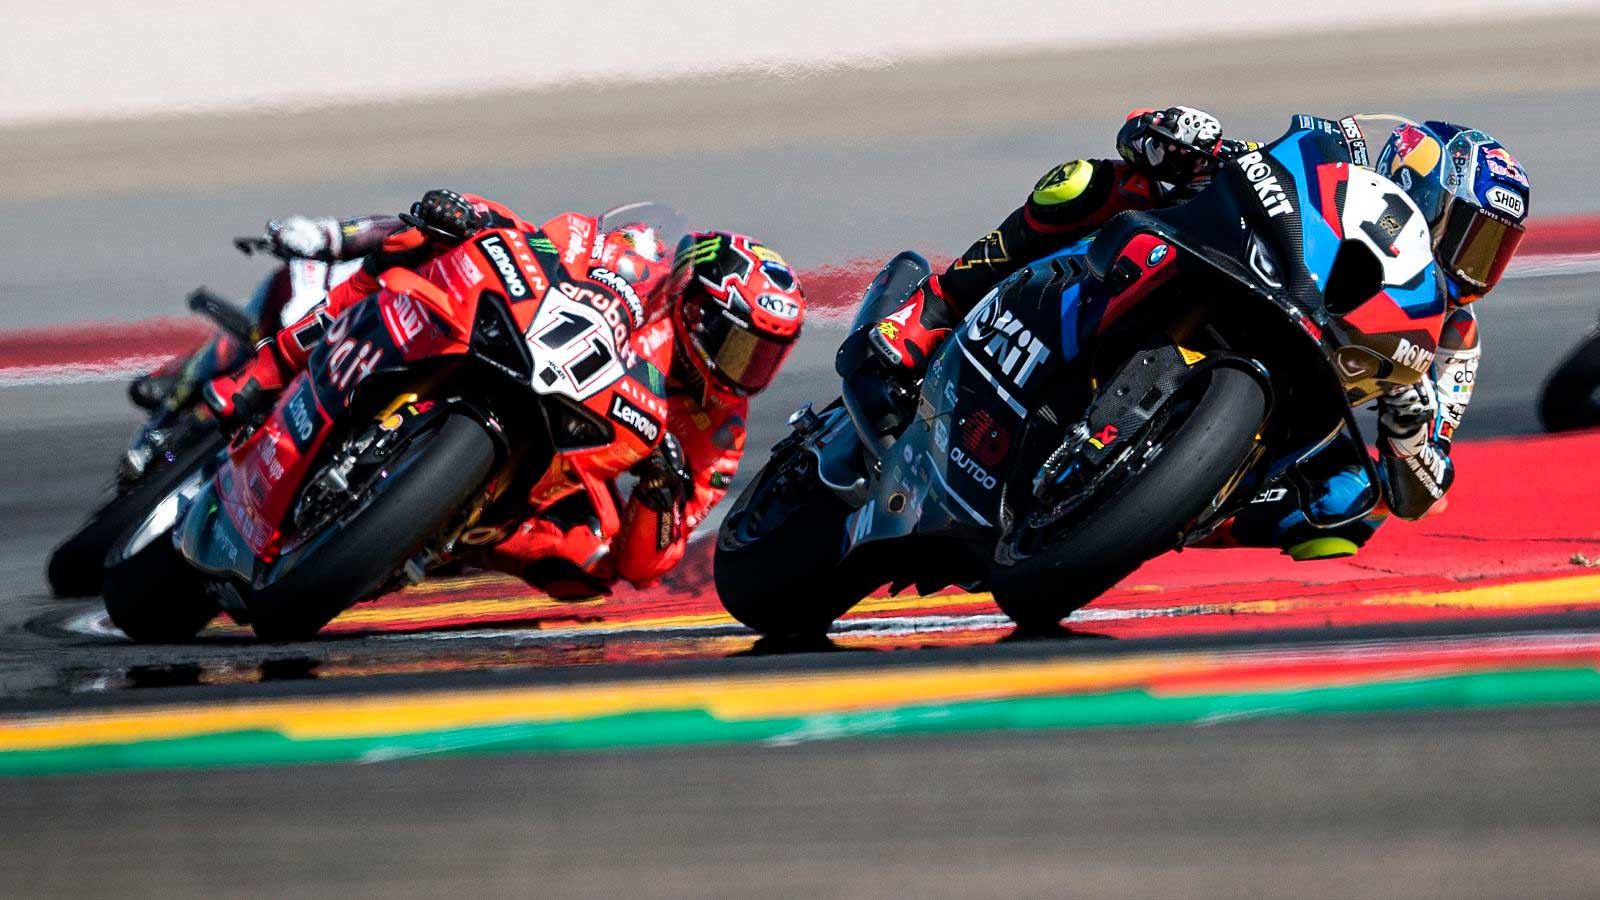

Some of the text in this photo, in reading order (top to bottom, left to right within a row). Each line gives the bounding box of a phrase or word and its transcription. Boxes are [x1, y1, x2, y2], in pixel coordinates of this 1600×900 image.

[1359, 193, 1414, 258] 1
[1494, 190, 1521, 213] SHOEI
[481, 236, 525, 297] Lenovo
[507, 230, 545, 291] ALTEN
[538, 310, 613, 385] 11
[964, 287, 1050, 388] OKiT
[612, 396, 658, 441] Lenovo
[950, 447, 997, 490] OUTDO
